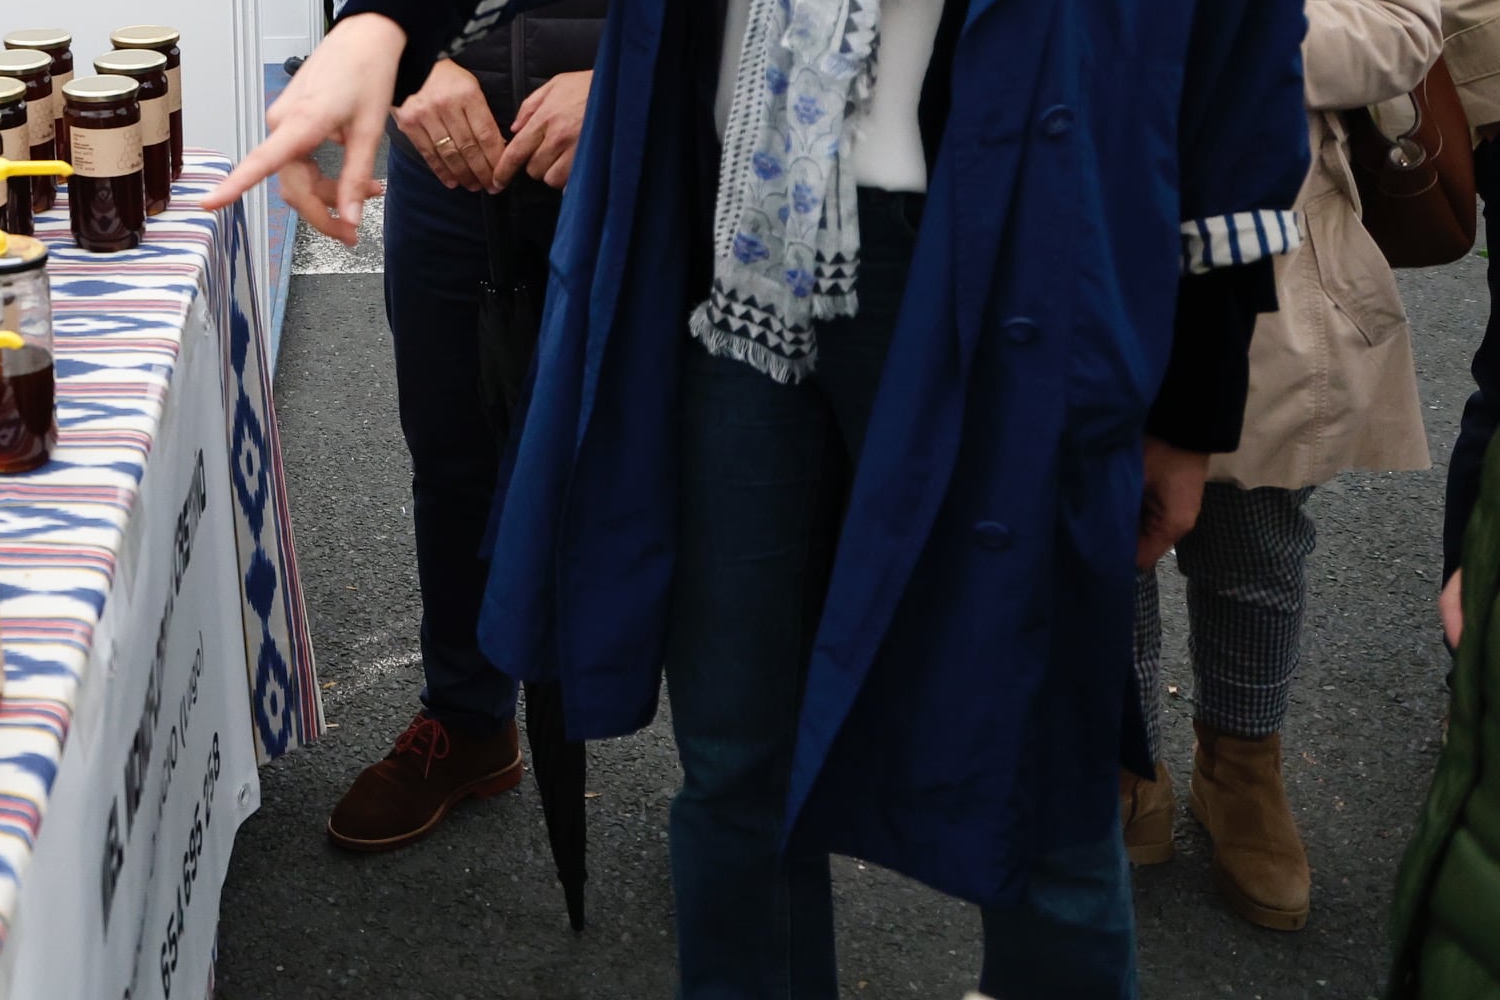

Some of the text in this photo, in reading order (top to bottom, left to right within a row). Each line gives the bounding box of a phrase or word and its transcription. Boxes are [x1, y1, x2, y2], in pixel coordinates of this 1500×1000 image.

[160, 732, 220, 1000] 654 695 258
